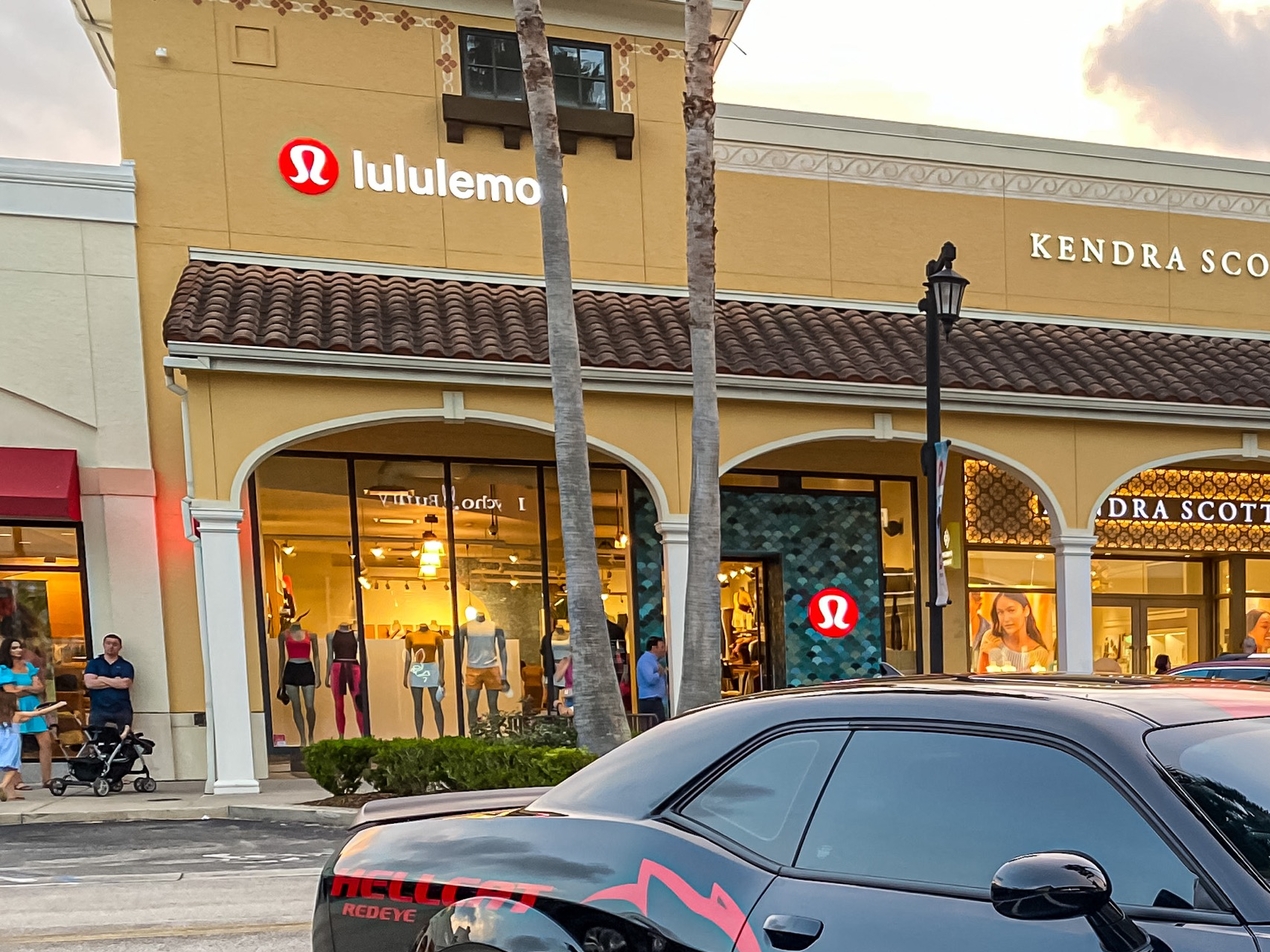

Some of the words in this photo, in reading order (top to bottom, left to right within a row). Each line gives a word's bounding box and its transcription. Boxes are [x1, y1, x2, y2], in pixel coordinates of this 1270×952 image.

[353, 149, 568, 205] lululemo
[1030, 232, 1186, 271] KENDRA
[330, 868, 554, 914] HELLCAT
[342, 903, 417, 923] REDEYE
